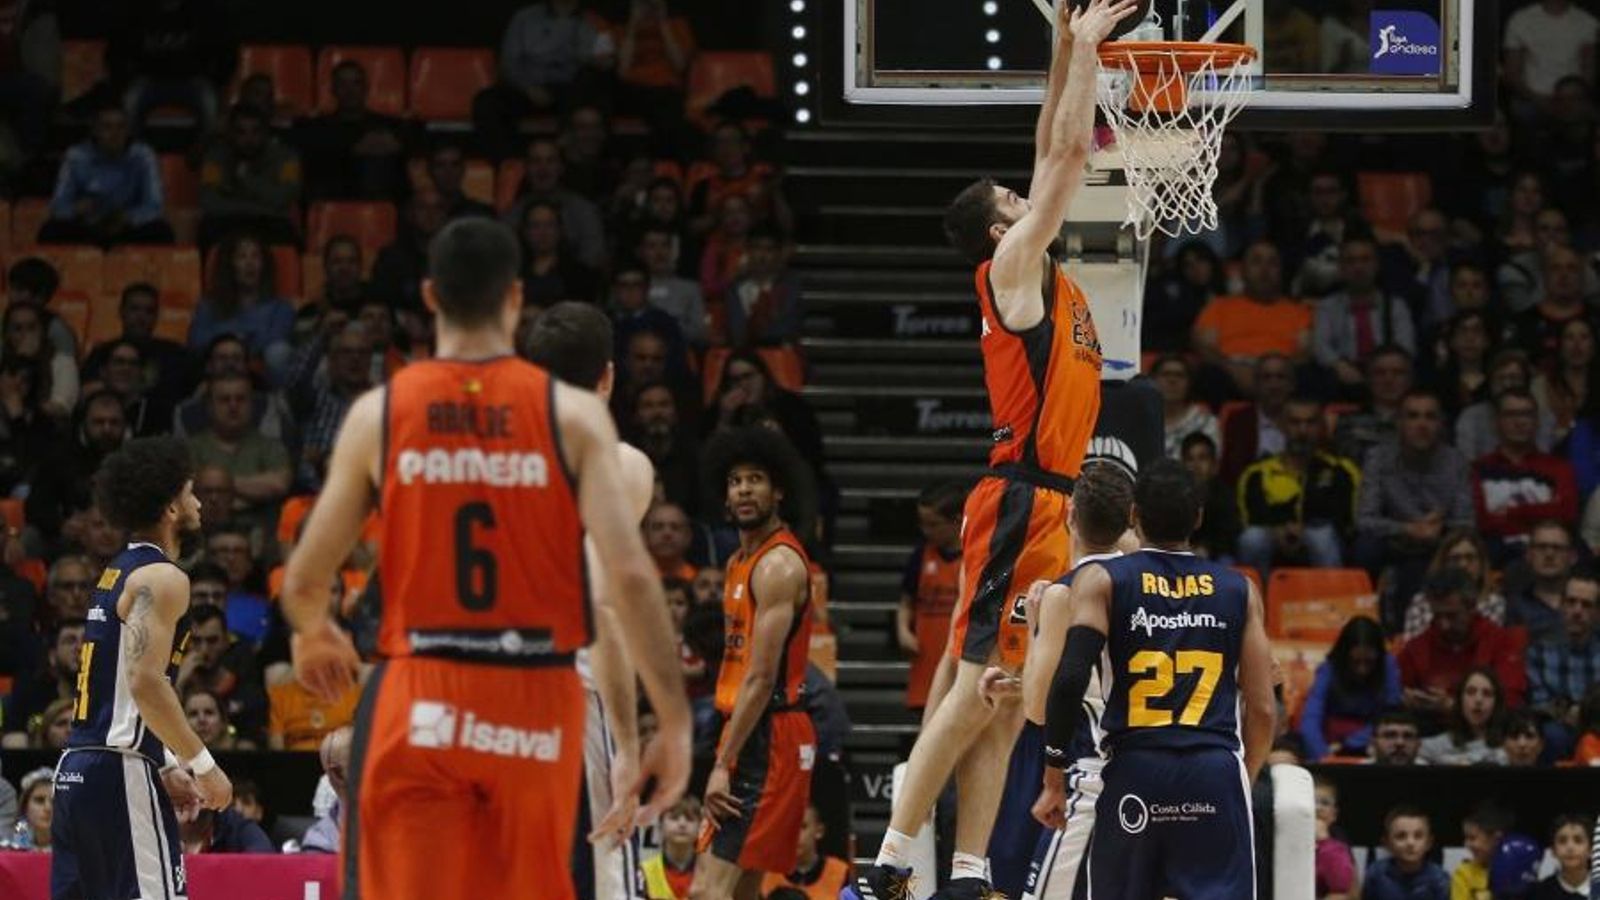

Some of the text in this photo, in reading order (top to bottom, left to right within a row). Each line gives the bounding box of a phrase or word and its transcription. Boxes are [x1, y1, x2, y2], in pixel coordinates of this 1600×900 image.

[455, 501, 498, 613] 6
[1141, 573, 1215, 599] ROJAS
[1128, 650, 1223, 727] 27
[461, 712, 562, 762] isaval
[1150, 803, 1179, 815] Costa
